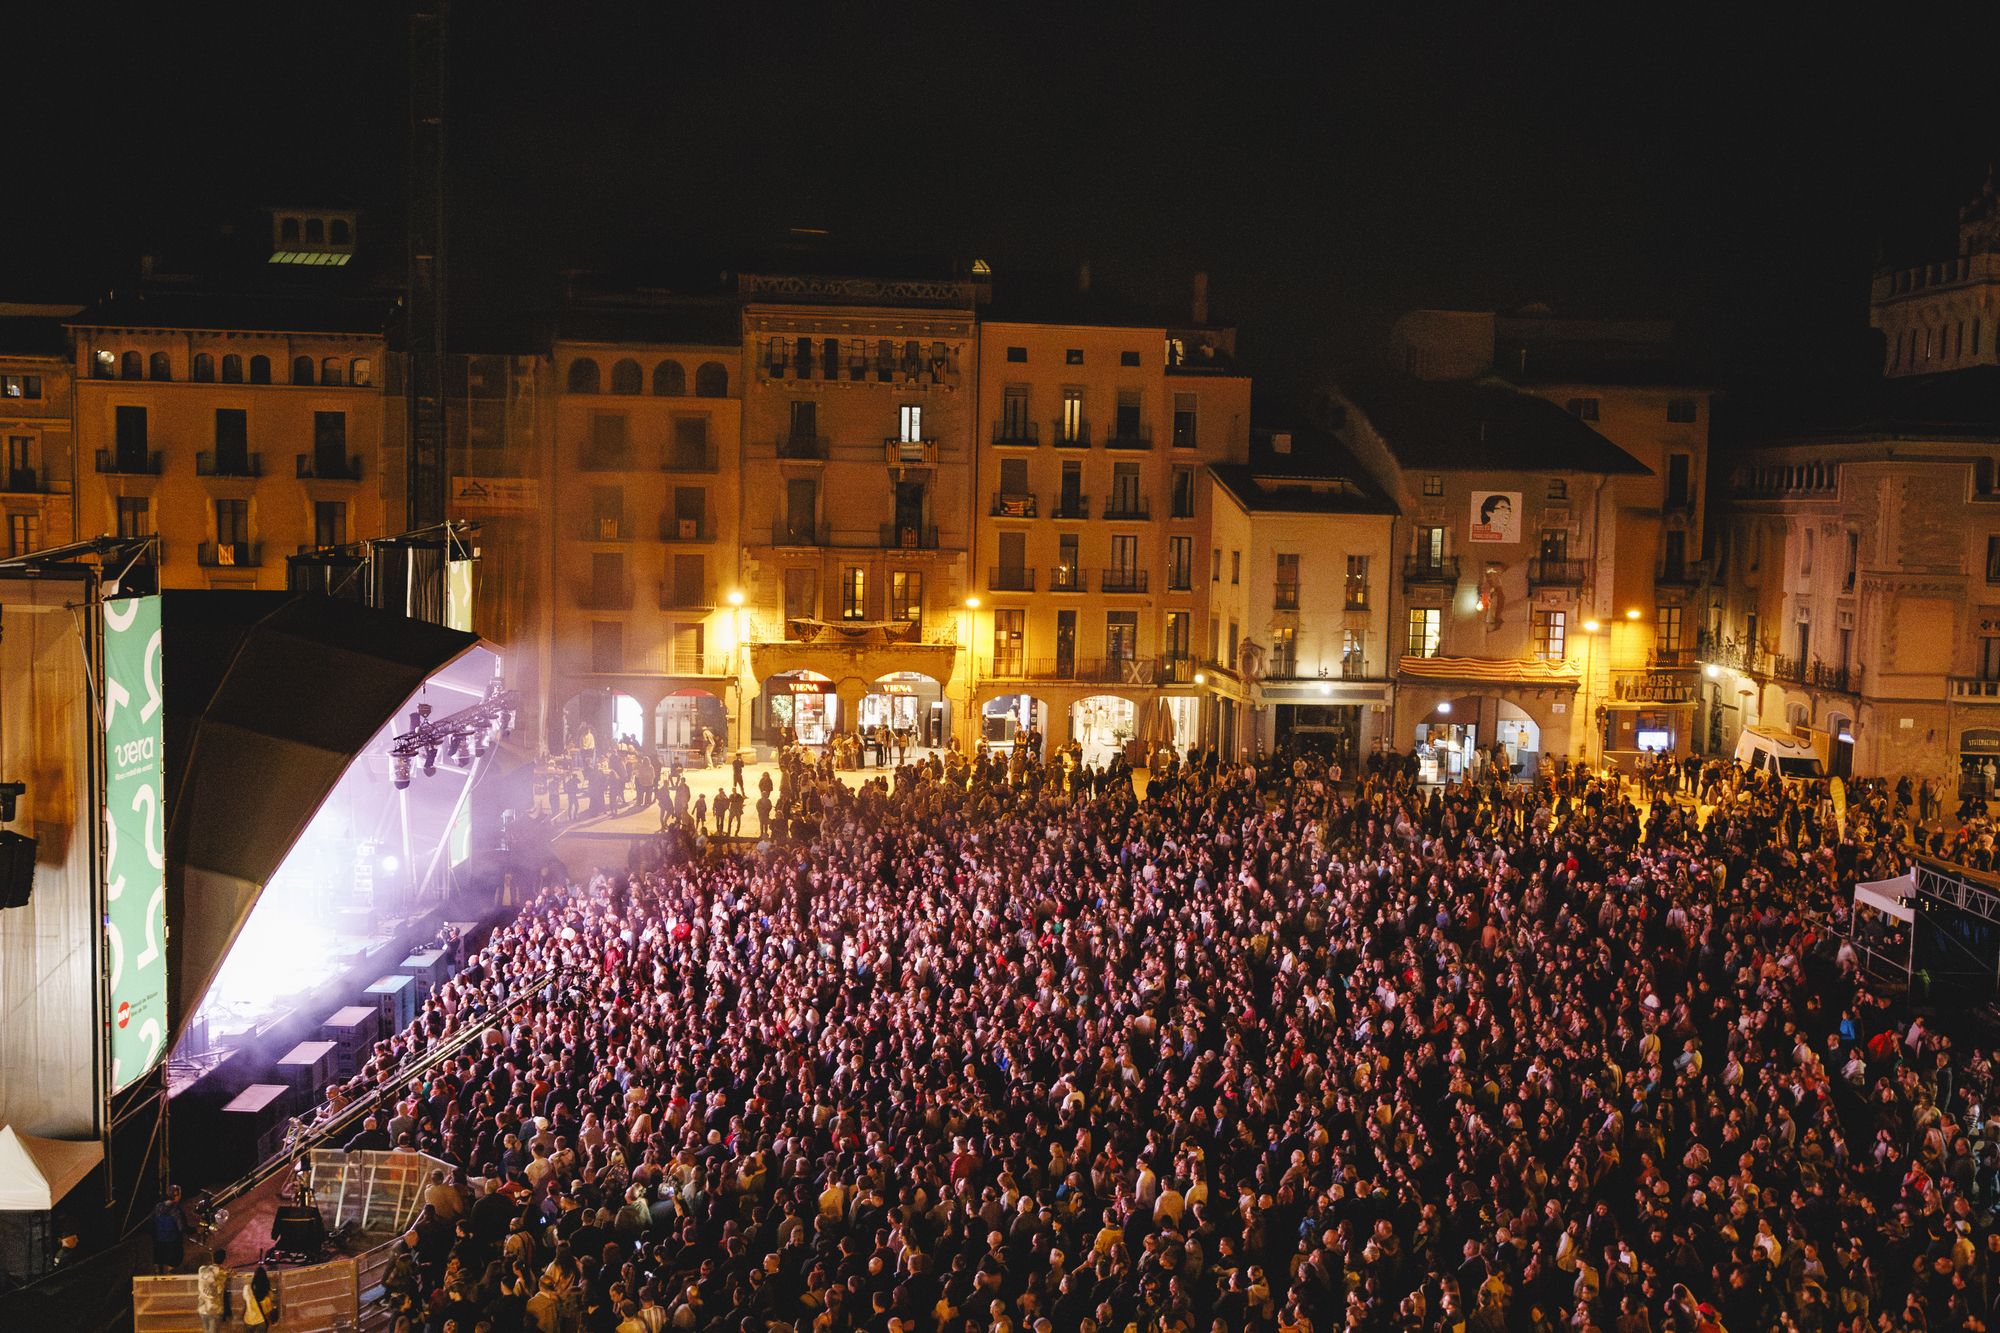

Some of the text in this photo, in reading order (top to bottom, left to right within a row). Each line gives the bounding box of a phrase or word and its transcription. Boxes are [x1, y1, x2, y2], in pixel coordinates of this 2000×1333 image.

[789, 683, 819, 692] VIENA
[882, 684, 913, 693] VIENA
[1626, 686, 1693, 702] ALEMANY
[115, 736, 154, 768] vera
